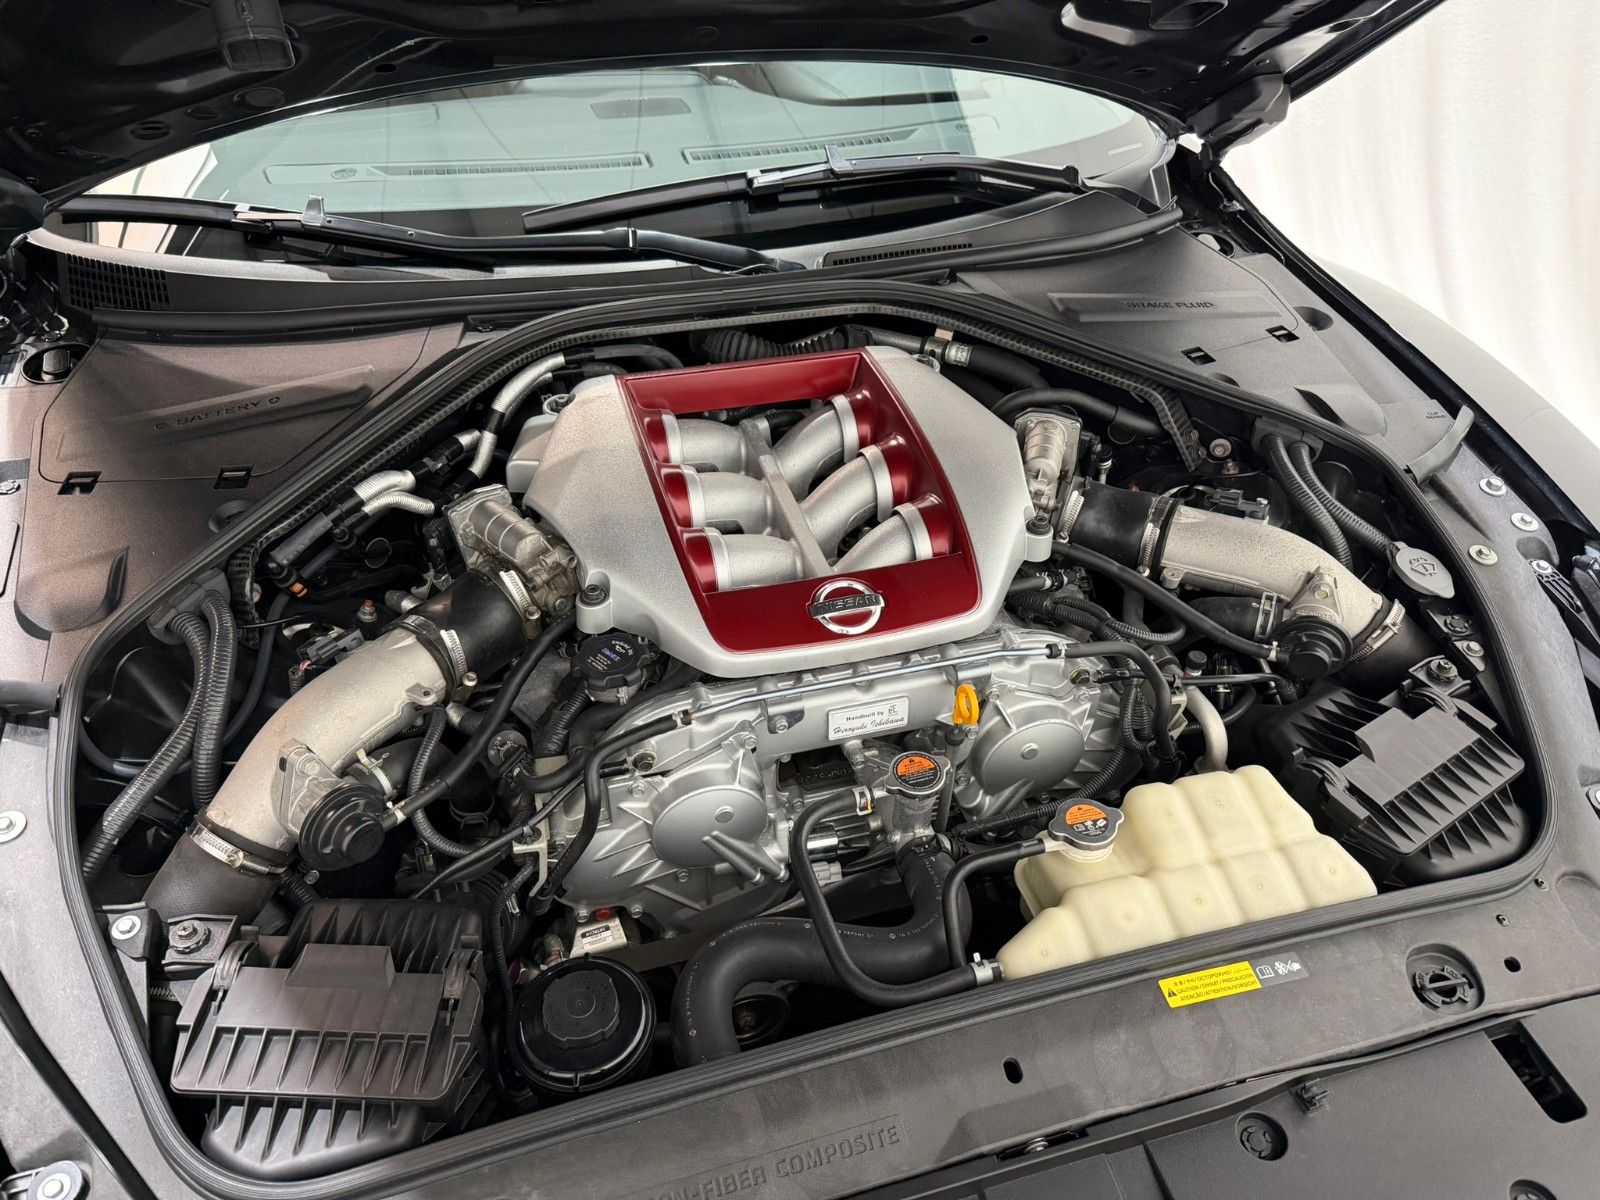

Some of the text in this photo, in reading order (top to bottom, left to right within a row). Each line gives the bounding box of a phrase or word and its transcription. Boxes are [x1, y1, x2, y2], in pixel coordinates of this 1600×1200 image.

[176, 400, 260, 426] BATTERY
[816, 595, 877, 611] NISSAN
[845, 711, 876, 721] Handbuilt
[1176, 985, 1200, 994] CAUTION
[775, 1125, 900, 1178] COMPOSITE
